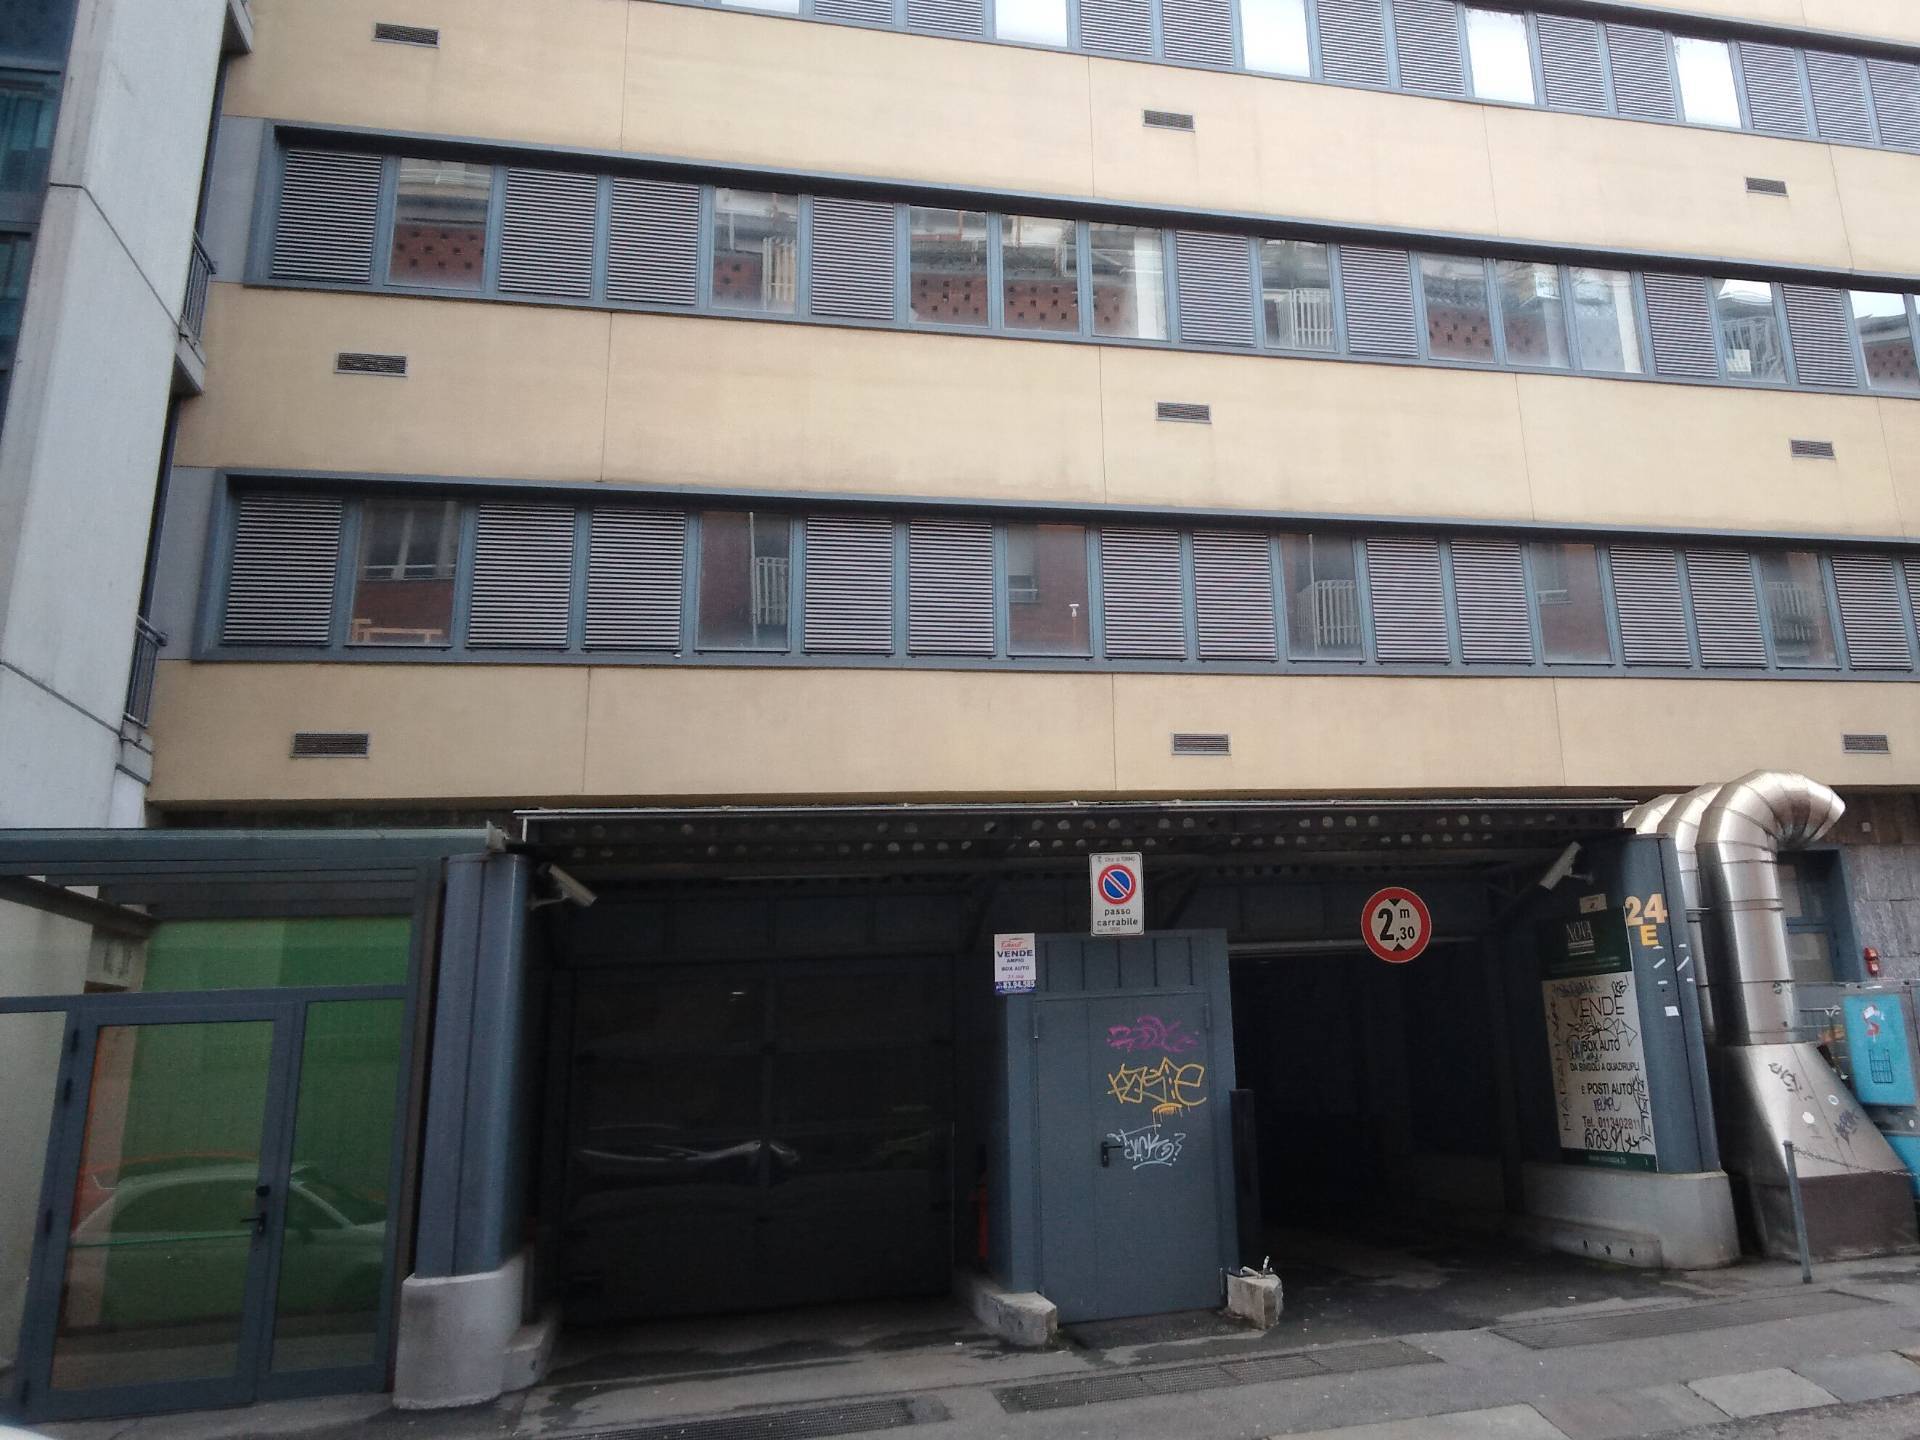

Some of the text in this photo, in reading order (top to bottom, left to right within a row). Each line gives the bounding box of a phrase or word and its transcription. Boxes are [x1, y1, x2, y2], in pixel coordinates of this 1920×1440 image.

[1624, 893, 1668, 926] 24
[1097, 918, 1138, 926] carrabile
[1640, 924, 1659, 946] E
[997, 949, 1033, 958] VENDE
[1569, 994, 1625, 1018] VENDE
[1581, 1039, 1621, 1052] BOX AUTO
[1570, 1062, 1579, 1072] DA
[1588, 1083, 1609, 1095] POSTI
[1612, 1083, 1633, 1095] AUTO
